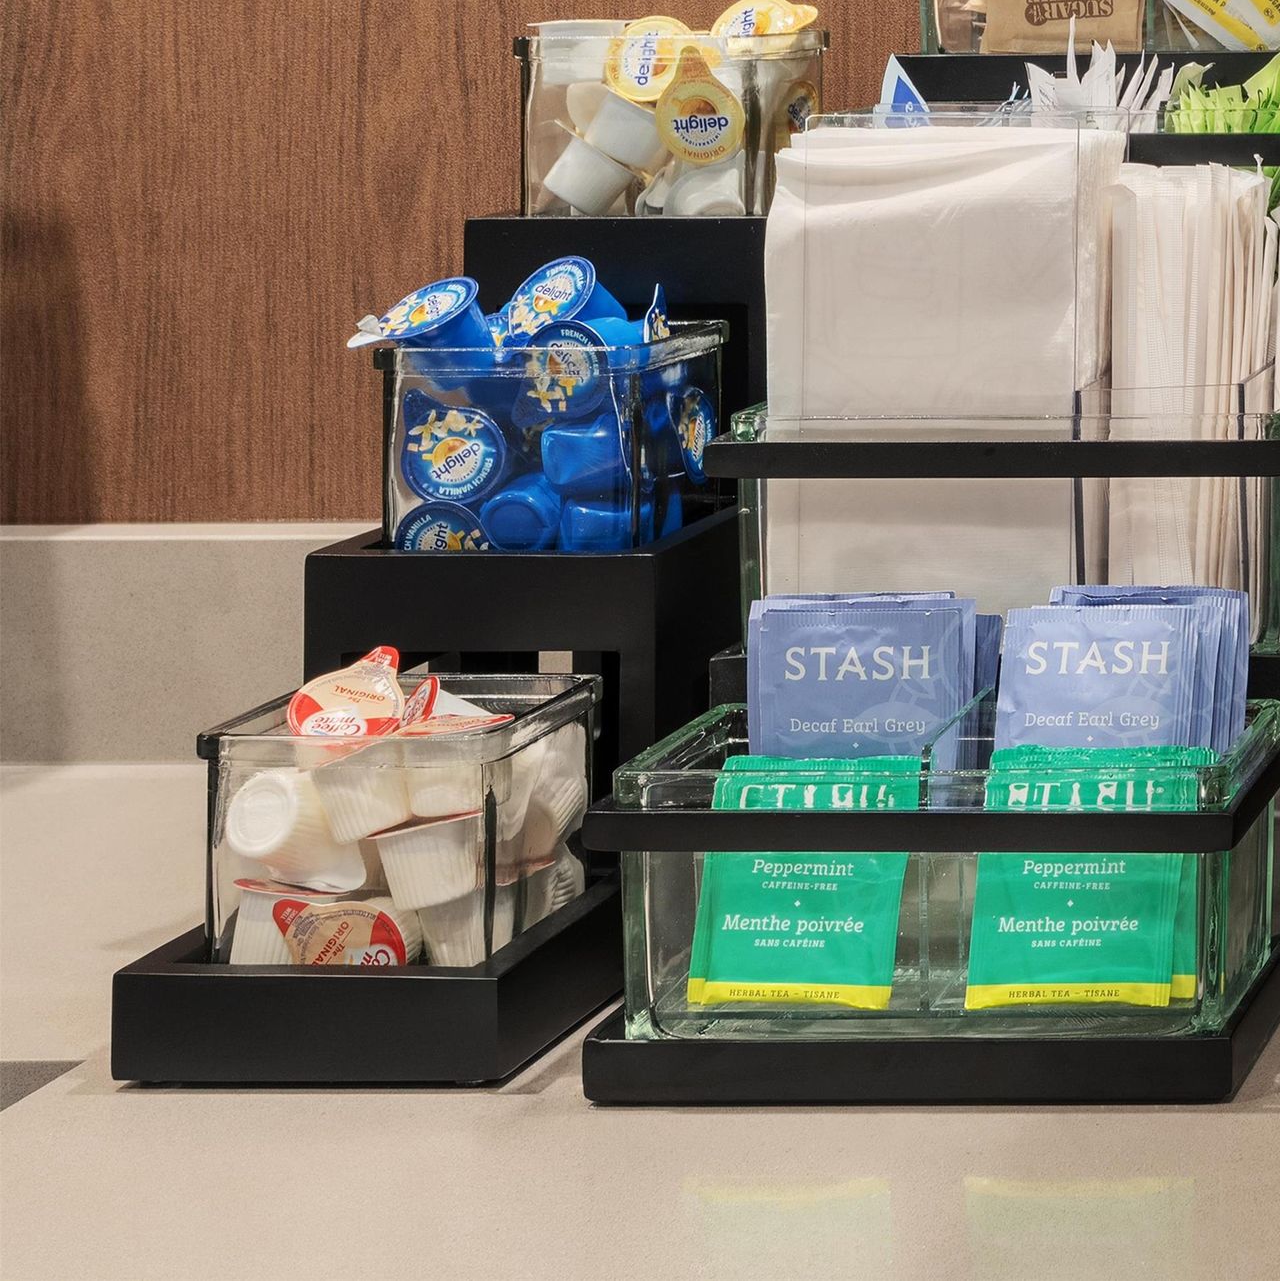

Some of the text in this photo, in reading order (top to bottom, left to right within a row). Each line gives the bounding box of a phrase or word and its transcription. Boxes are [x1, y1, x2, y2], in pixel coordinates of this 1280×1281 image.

[672, 114, 730, 136] delight
[534, 283, 573, 302] delight
[431, 441, 482, 481] delight
[437, 457, 495, 496] FRENCH VANILLA
[406, 513, 432, 542] VANILLA
[784, 645, 933, 681] STASH
[1025, 640, 1171, 675] STASH
[333, 684, 386, 702] ORIGINAL
[789, 718, 927, 736] Decaf Earl Grey
[1024, 711, 1161, 731] Decaf Earl Grey
[752, 858, 855, 878] Peppermint
[1022, 858, 1127, 878] Peppermint
[762, 880, 839, 891] CAFFEINE-FREE
[1033, 881, 1111, 891] CAFFEINE-FREE
[721, 913, 865, 935] Menthe poivrée
[997, 915, 1140, 936] Menthe poivrée
[754, 938, 780, 948] SANS
[1031, 939, 1057, 948] SANS
[729, 988, 841, 999] HERBAL TEA TISANE
[1008, 989, 1121, 999] HERBAL TEA TISANE
